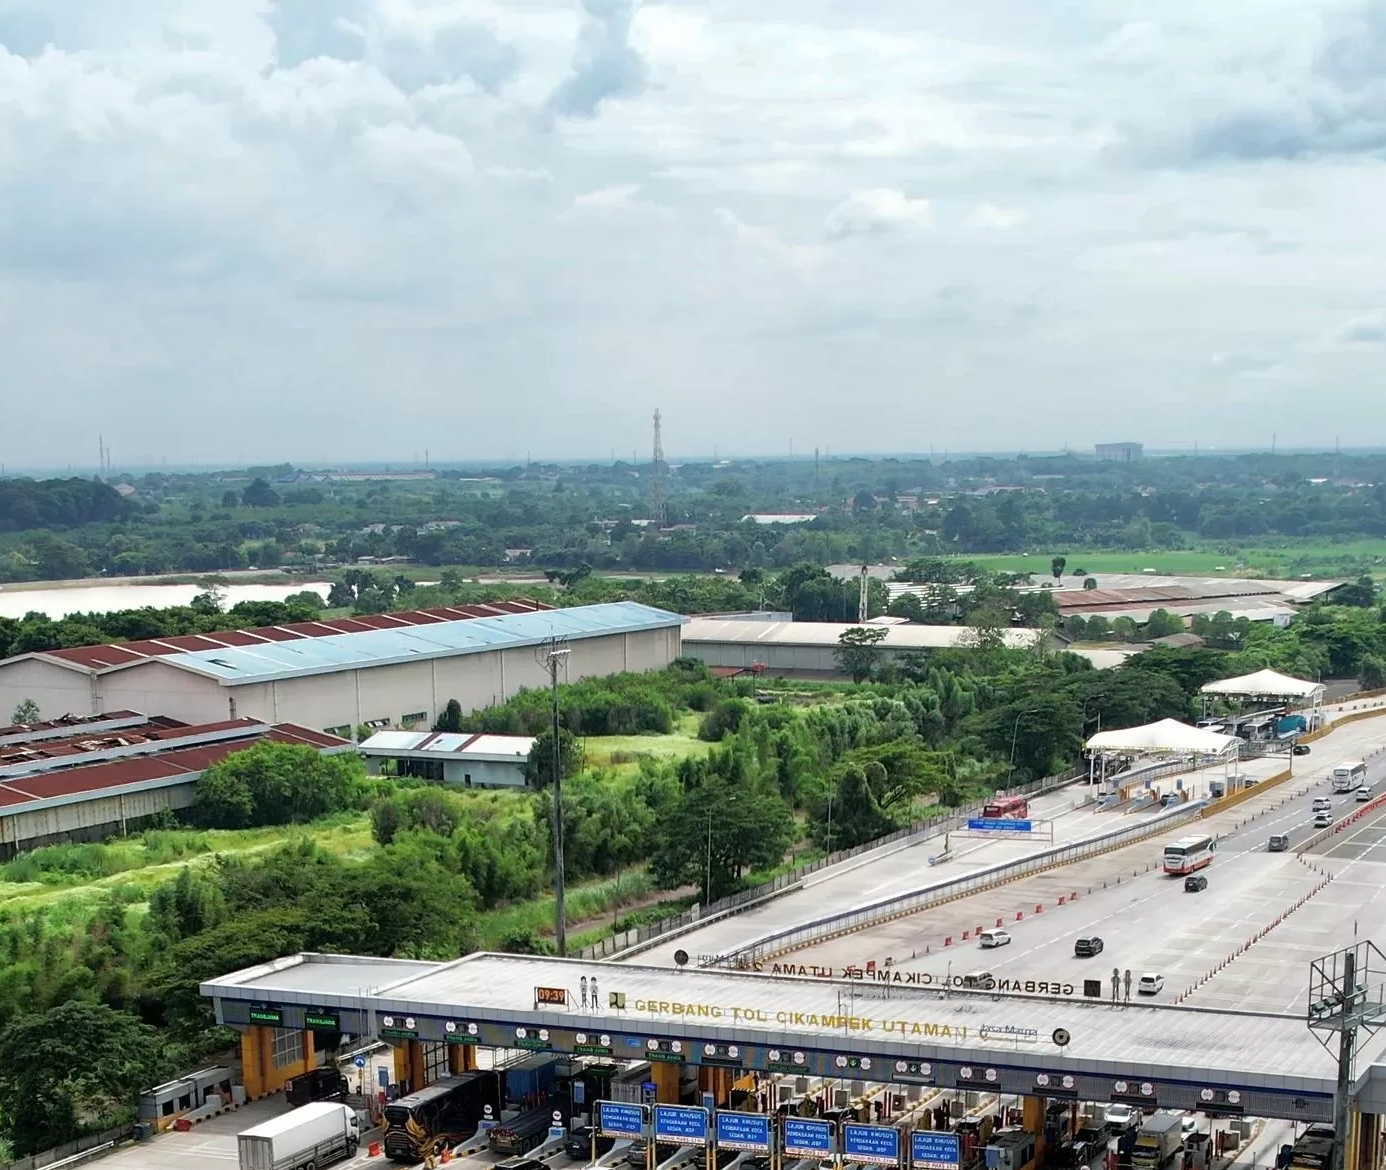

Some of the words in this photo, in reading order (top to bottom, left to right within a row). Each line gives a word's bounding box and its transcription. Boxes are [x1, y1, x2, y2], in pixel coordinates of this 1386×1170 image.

[538, 989, 564, 1001] 09:39
[635, 999, 722, 1018] GERBANG
[730, 1007, 767, 1022] TOL
[776, 1011, 874, 1031] CIKAMPEK
[882, 1019, 952, 1039] UTAMA
